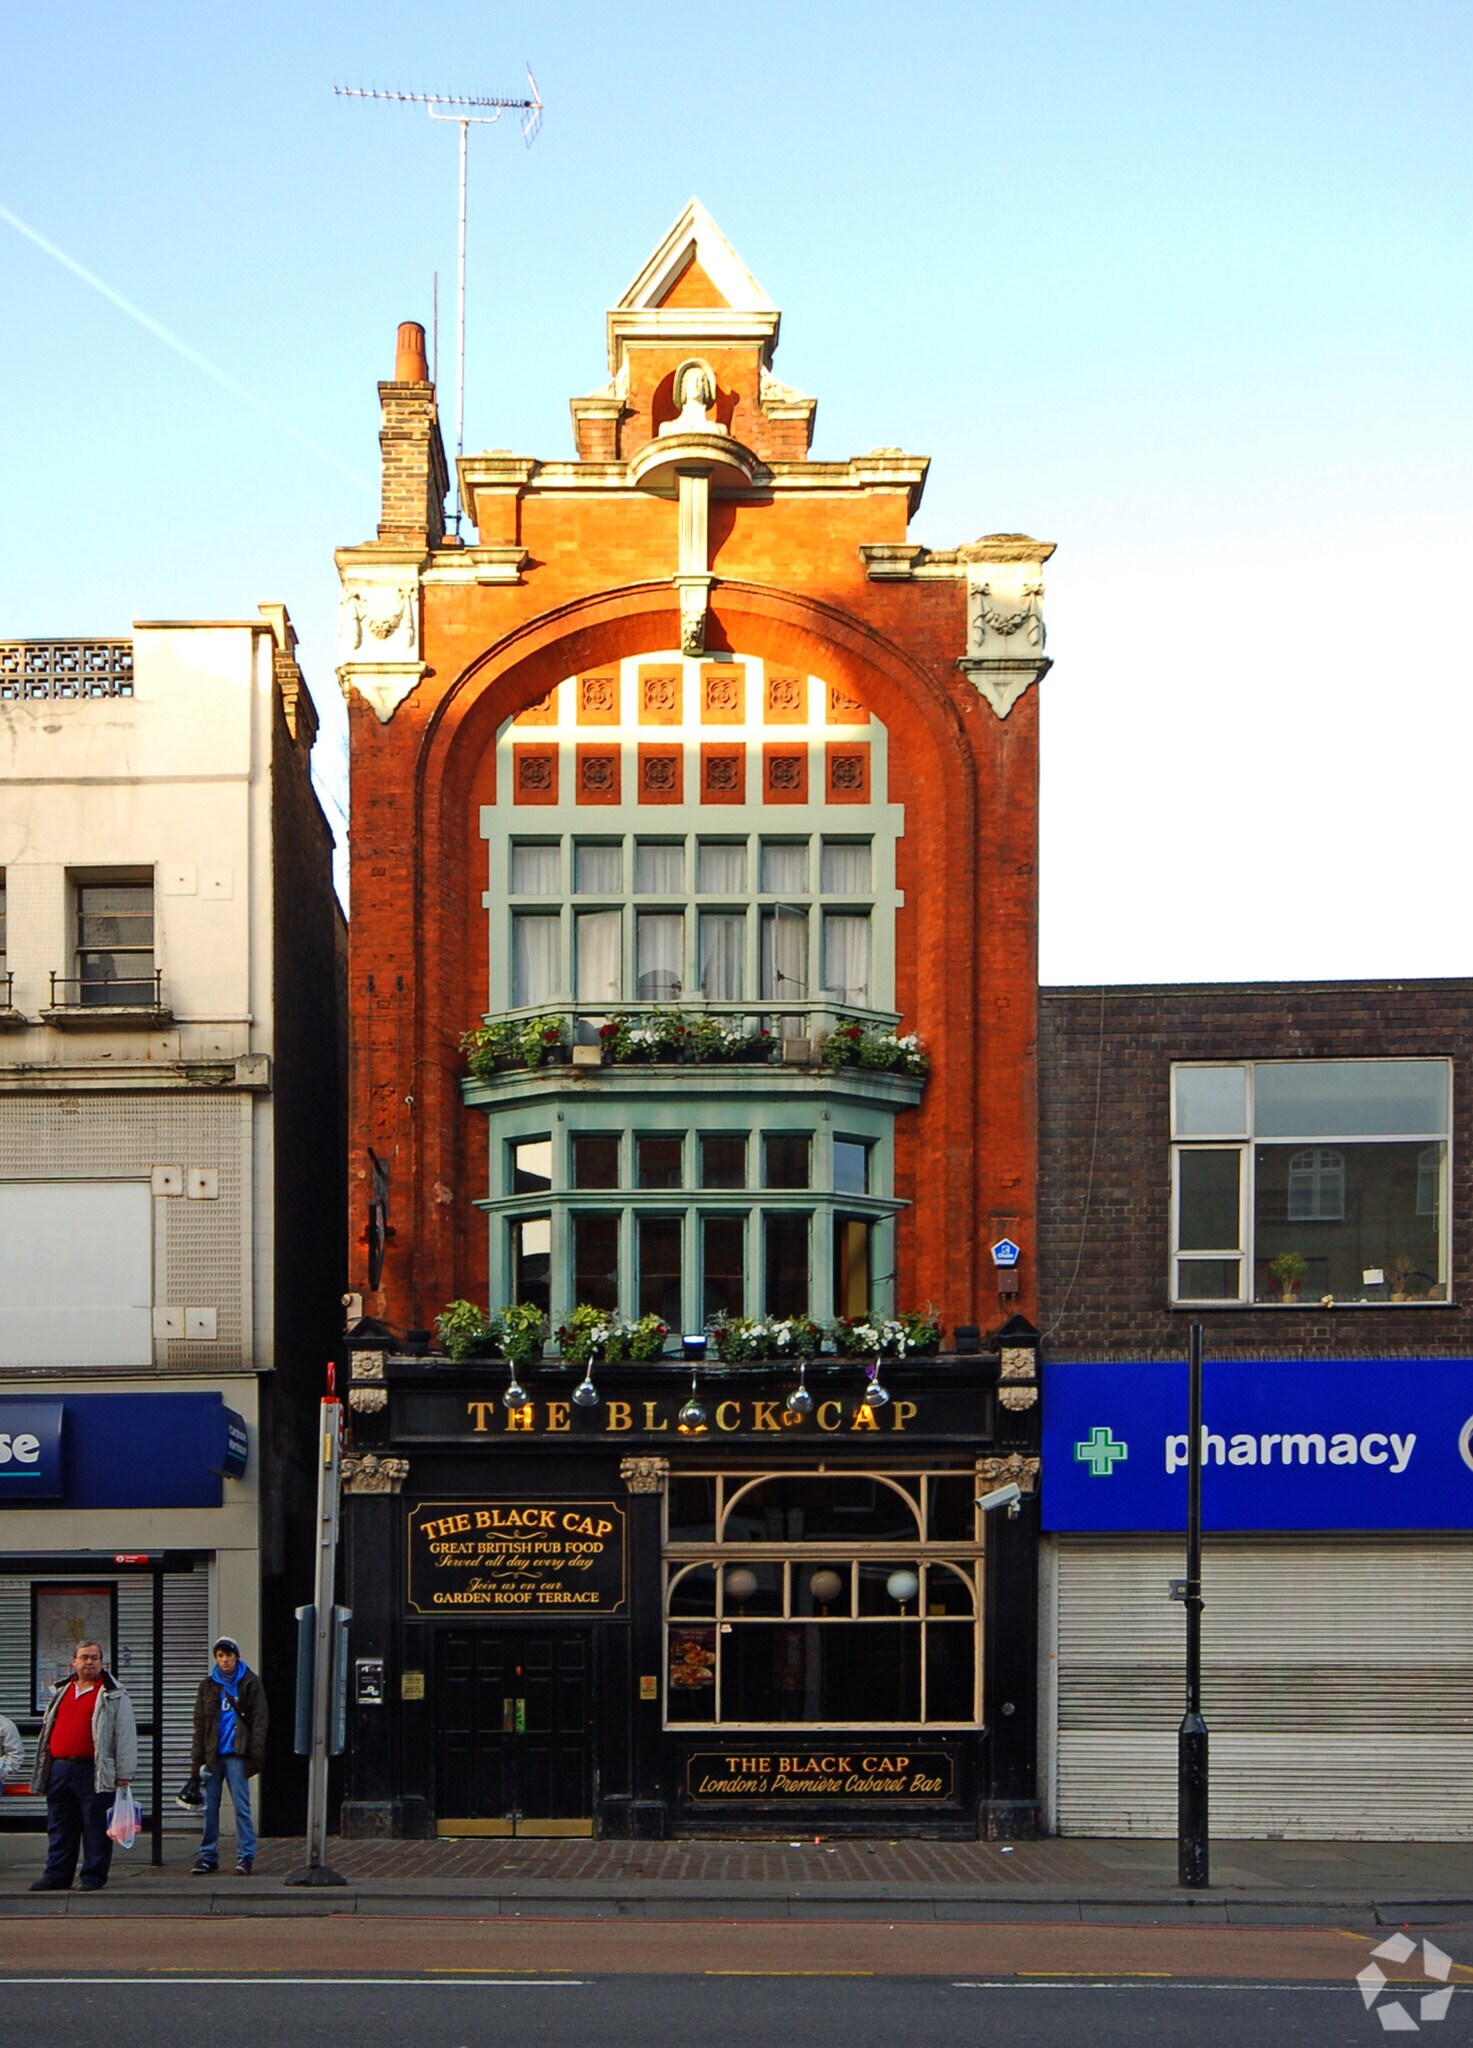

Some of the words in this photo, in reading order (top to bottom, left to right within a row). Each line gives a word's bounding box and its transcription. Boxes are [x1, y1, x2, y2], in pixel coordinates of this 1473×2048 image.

[467, 1401, 571, 1431] THE
[605, 1401, 782, 1431] BLCK
[816, 1401, 918, 1431] CAP
[1165, 1424, 1417, 1474] pharmacy
[420, 1514, 471, 1540] THE
[474, 1509, 556, 1529] BLACK
[562, 1512, 613, 1538] CAP
[429, 1542, 475, 1554] GREAT
[477, 1542, 532, 1554] BRITISH
[534, 1542, 561, 1554] PUB
[564, 1542, 604, 1554] FOOD
[435, 1554, 482, 1569] Served
[485, 1554, 506, 1568] all
[506, 1554, 530, 1571] day
[533, 1558, 565, 1571] every
[568, 1554, 594, 1571] day
[466, 1577, 497, 1593] Join
[520, 1581, 536, 1591] on
[540, 1581, 563, 1591] our
[433, 1592, 491, 1604] GARDEN
[494, 1592, 532, 1604] ROOF
[536, 1592, 600, 1604] TERRACE
[725, 1757, 771, 1773] THE
[778, 1757, 852, 1773] BLACK
[862, 1757, 910, 1773] CAP
[699, 1774, 768, 1793] London's
[845, 1774, 907, 1793] Cabaret
[909, 1773, 943, 1792] Bar
